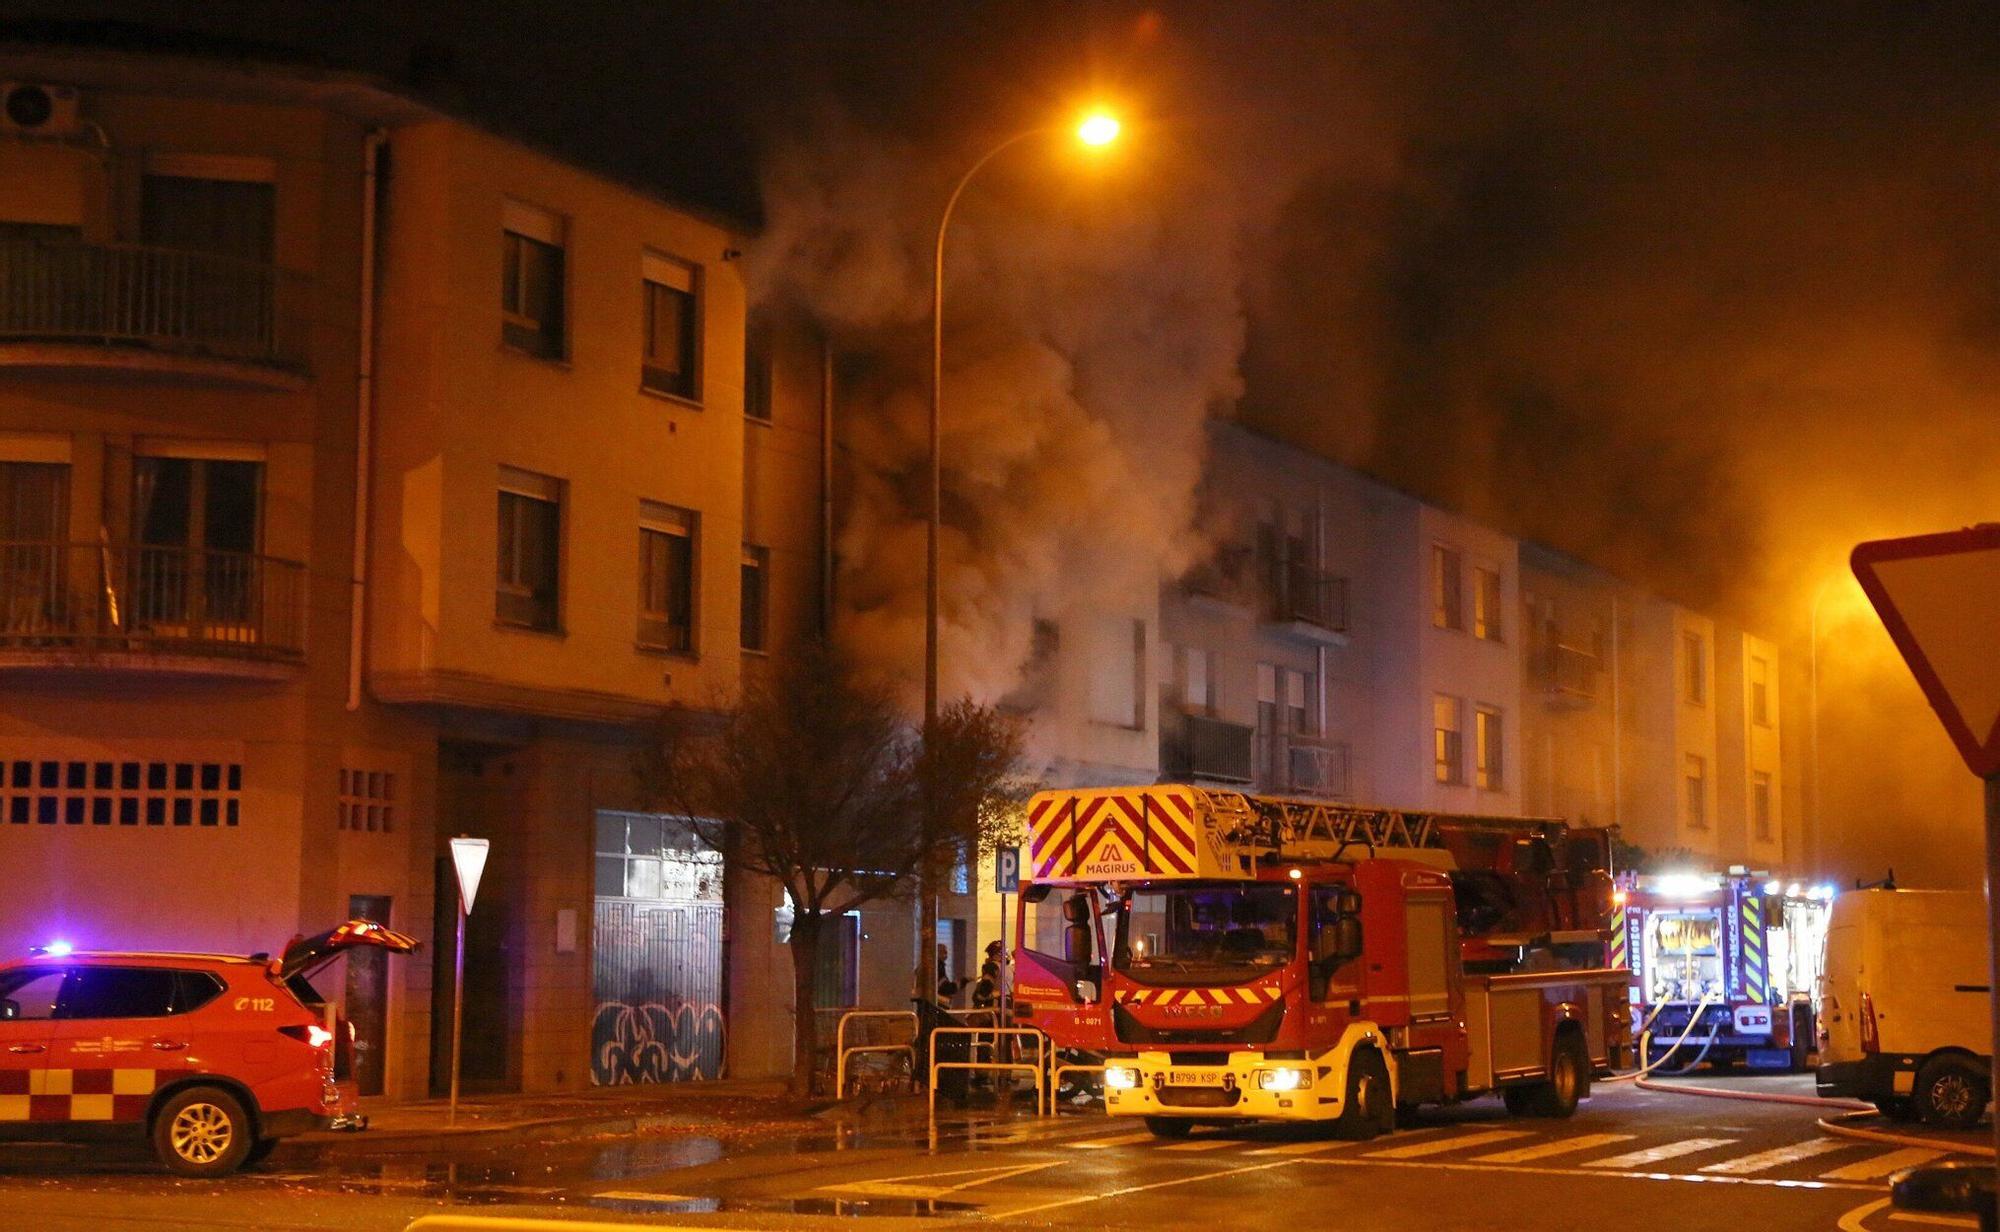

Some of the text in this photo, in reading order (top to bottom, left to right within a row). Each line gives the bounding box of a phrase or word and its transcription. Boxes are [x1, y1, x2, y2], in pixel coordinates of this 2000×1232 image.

[1001, 850, 1016, 888] P
[1086, 863, 1136, 874] MAGIRUS
[252, 998, 274, 1011] 112
[1175, 1072, 1217, 1083] 8799 KSP
